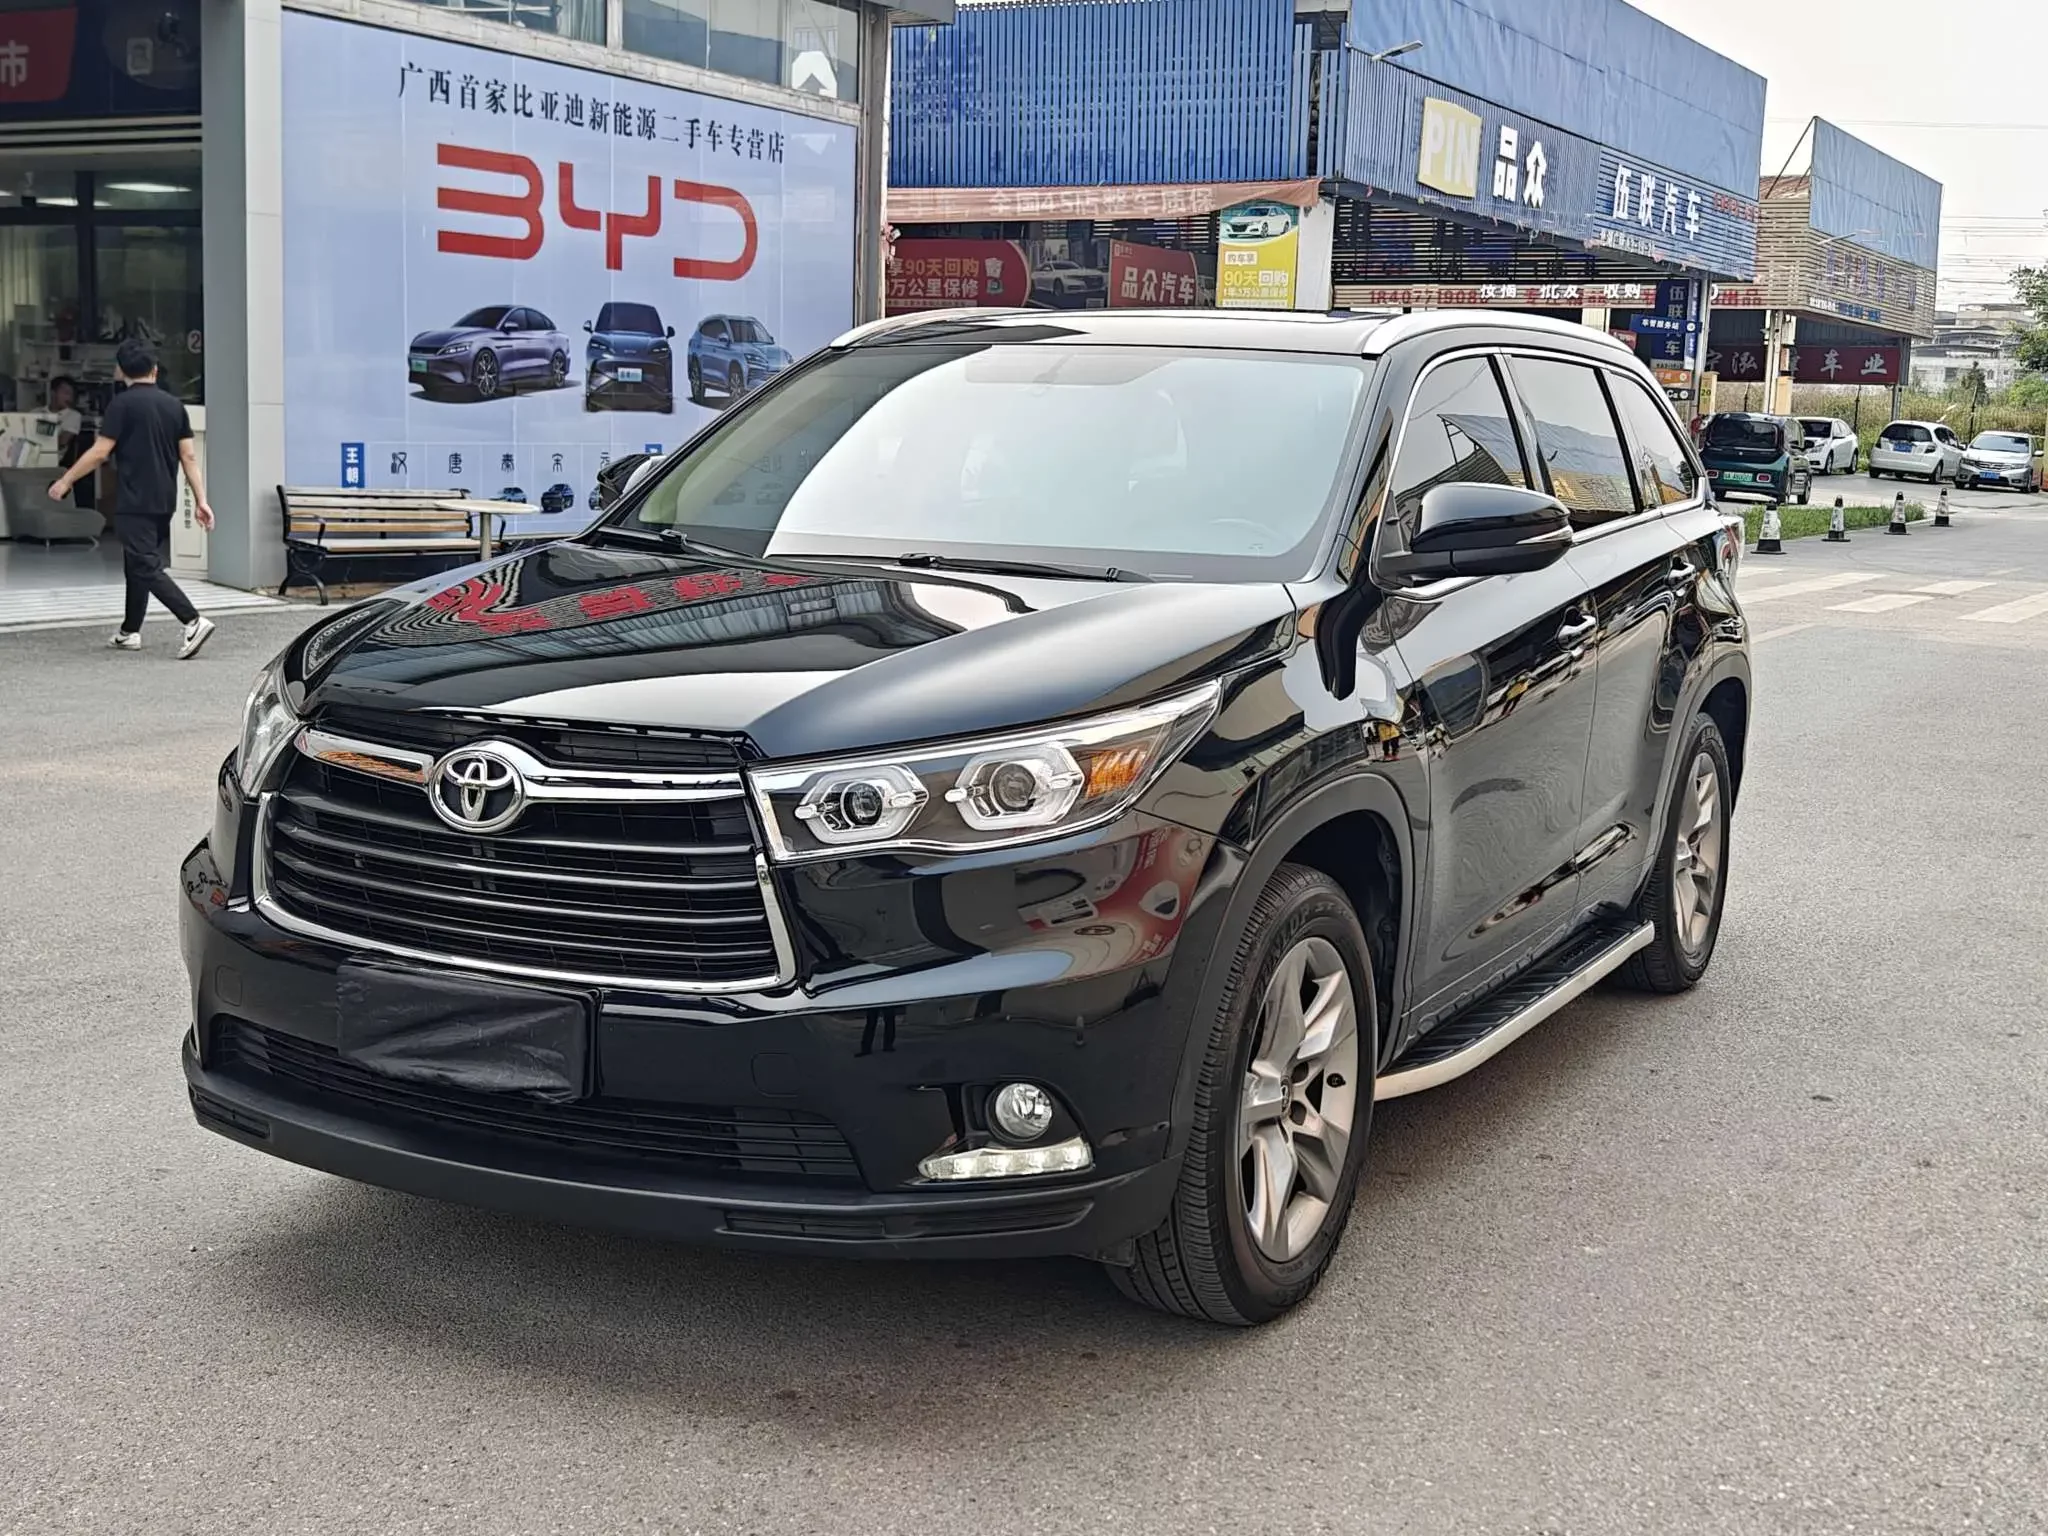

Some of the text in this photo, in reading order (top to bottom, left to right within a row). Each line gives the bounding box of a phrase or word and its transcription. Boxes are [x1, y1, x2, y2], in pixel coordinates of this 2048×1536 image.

[0, 40, 29, 87] 市
[398, 62, 786, 164] 广西首家比亚迪新能源二手车专营店
[1422, 107, 1481, 196] PIN
[1493, 124, 1547, 208] 品众
[437, 142, 758, 281] BYD
[1611, 163, 1702, 242] 伍联汽车
[1121, 266, 1195, 305] 品众汽车
[1223, 270, 1289, 287] 90天回购
[1665, 286, 1684, 356] 伍联车
[346, 447, 359, 484] 王朝
[448, 452, 462, 474] 唐
